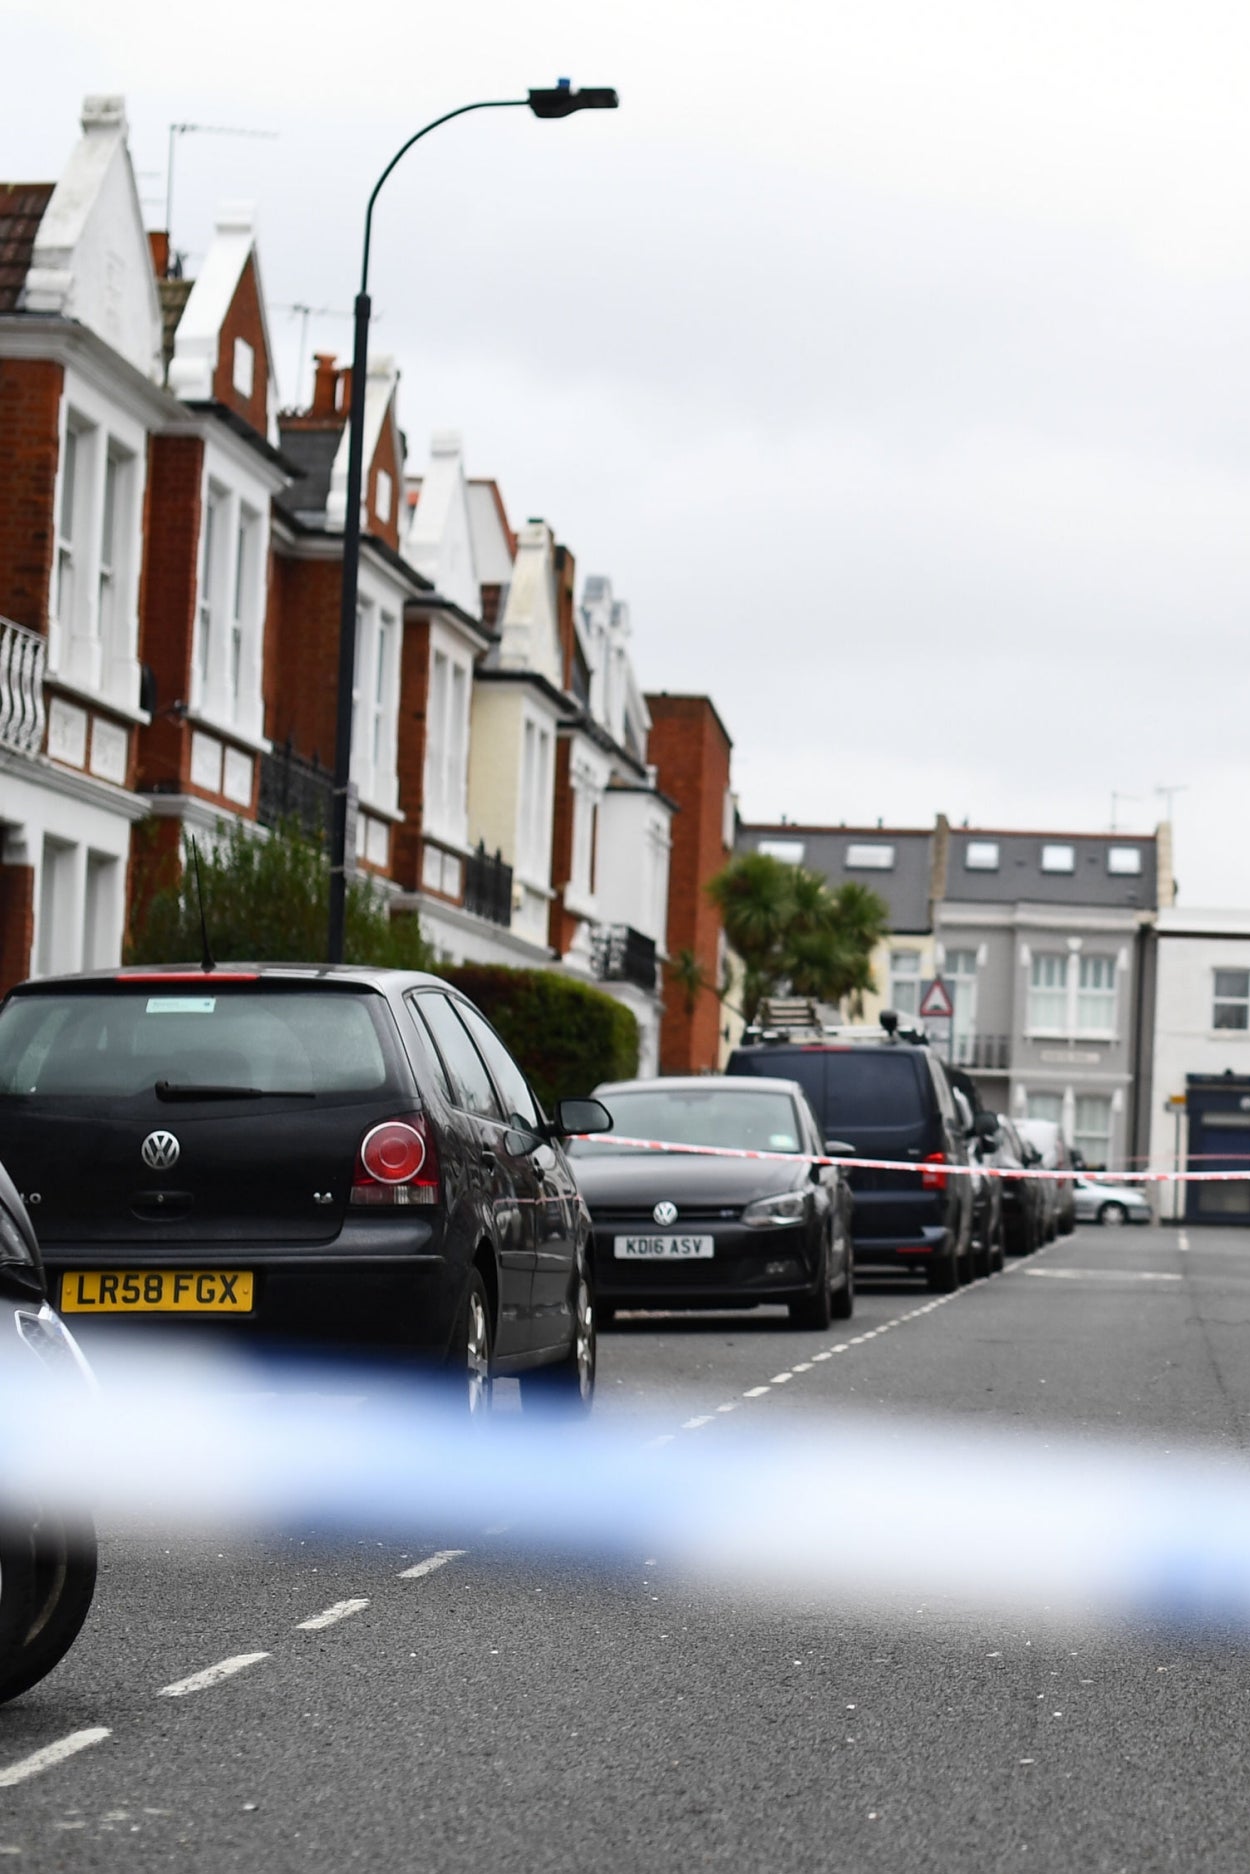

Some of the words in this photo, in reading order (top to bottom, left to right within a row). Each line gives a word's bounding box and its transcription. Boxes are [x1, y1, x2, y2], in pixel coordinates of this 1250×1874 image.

[625, 1238, 665, 1255] KD16
[670, 1238, 703, 1255] ASV
[77, 1274, 163, 1305] LR58
[173, 1273, 239, 1305] FGX
